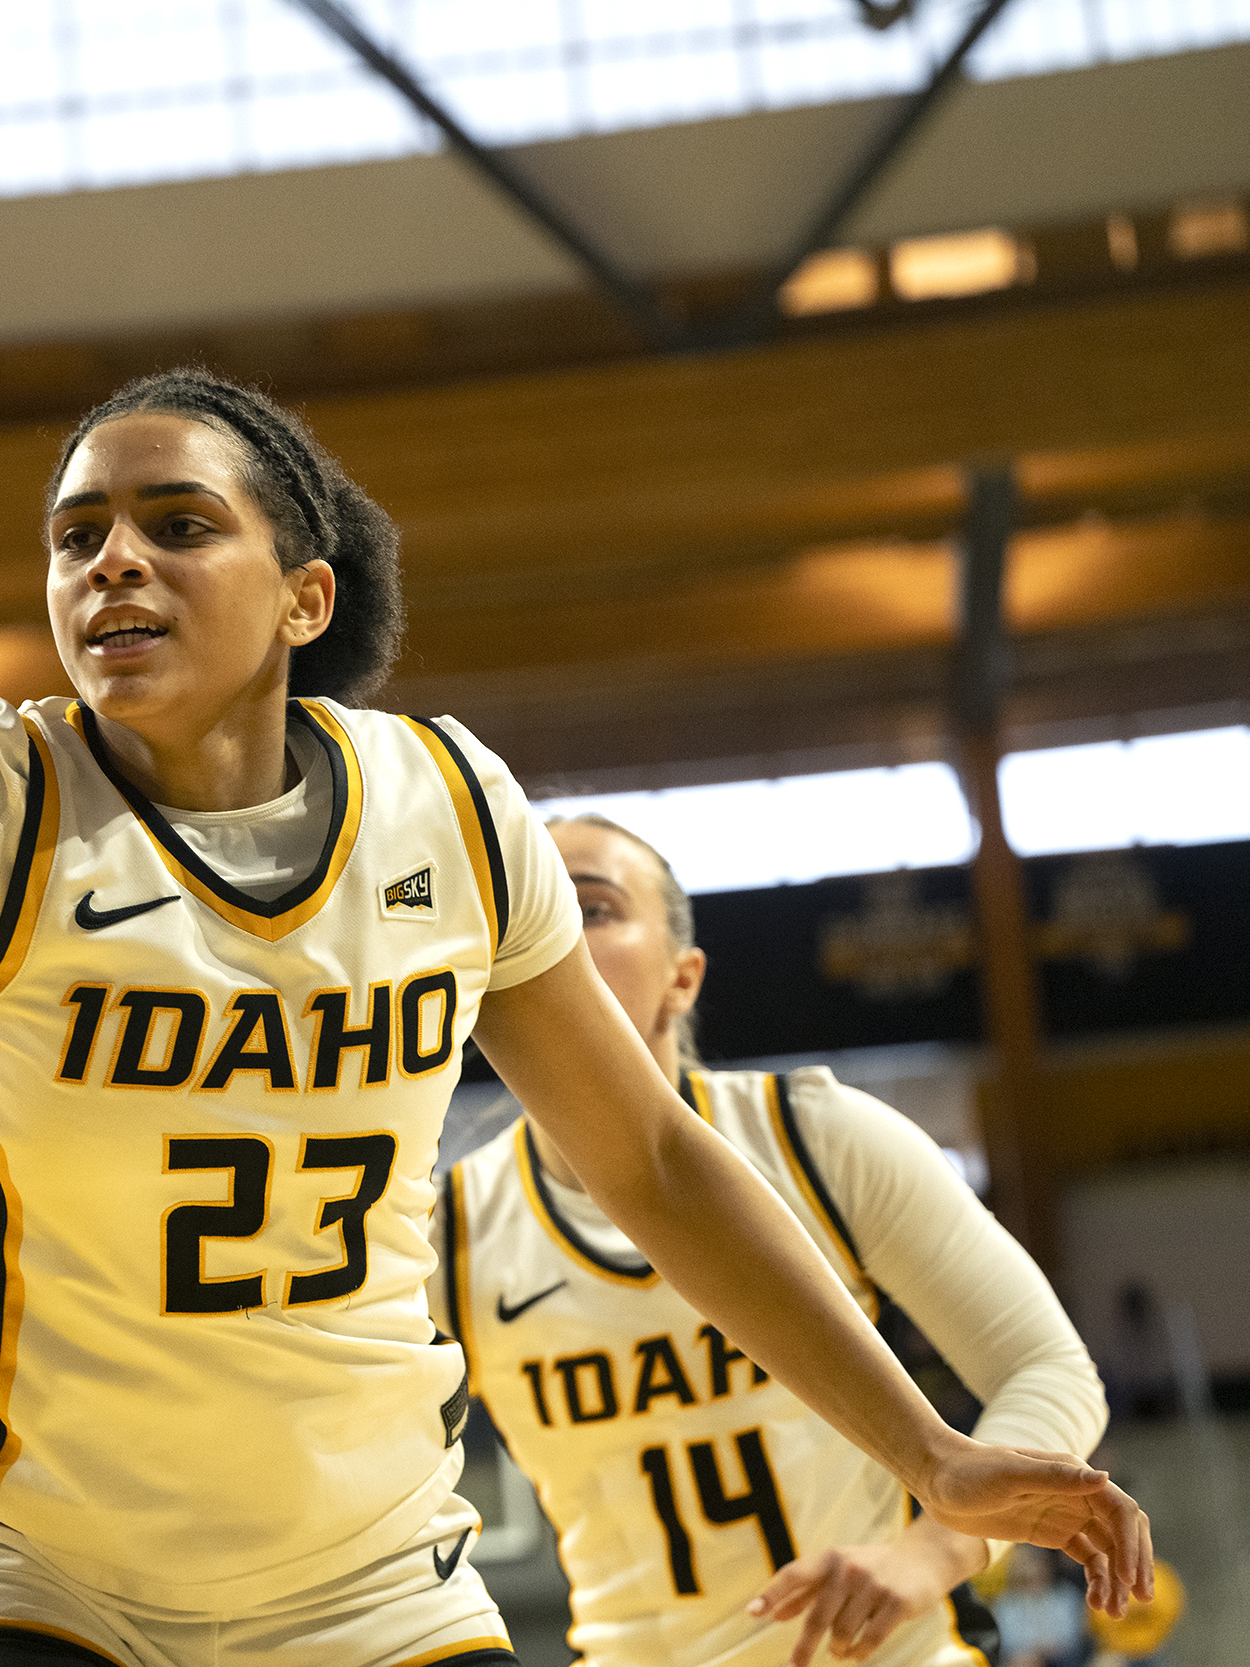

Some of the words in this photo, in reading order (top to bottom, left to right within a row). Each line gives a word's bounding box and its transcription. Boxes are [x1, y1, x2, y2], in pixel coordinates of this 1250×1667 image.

[53, 965, 458, 1093] IDAHO
[160, 1129, 400, 1316] 23
[518, 1322, 769, 1428] IDAH
[639, 1425, 798, 1597] 14
